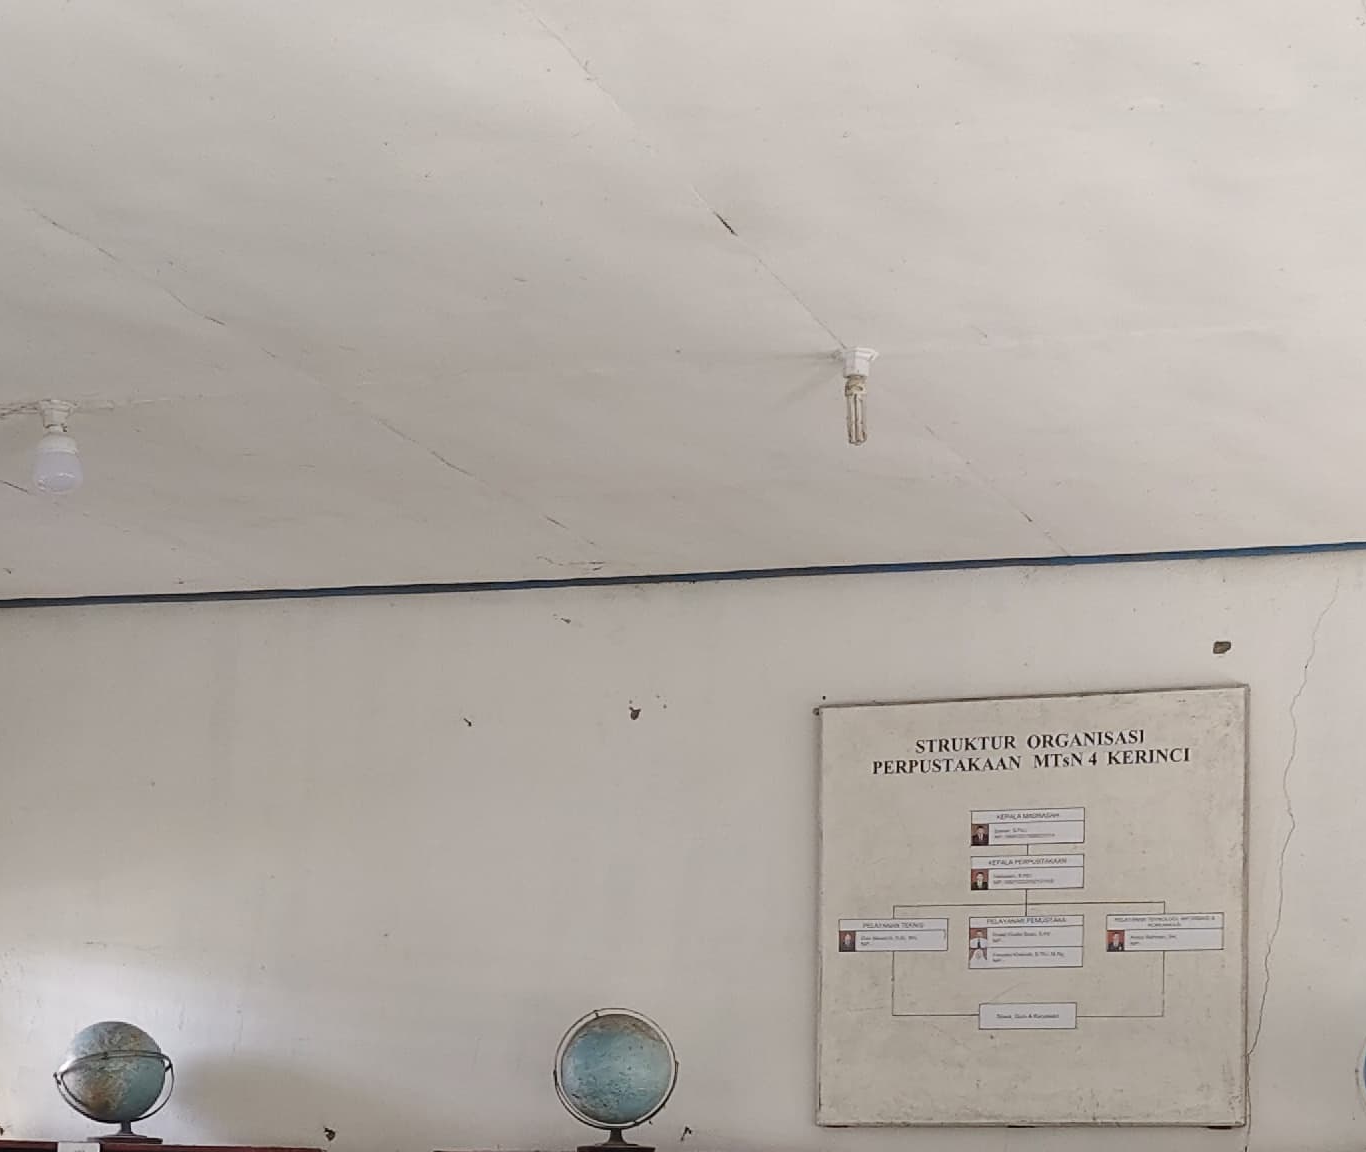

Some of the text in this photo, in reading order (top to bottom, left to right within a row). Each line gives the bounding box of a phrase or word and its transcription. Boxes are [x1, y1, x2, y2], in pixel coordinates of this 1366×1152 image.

[915, 729, 1144, 753] STRUKTUR ORGANISASI
[872, 747, 1190, 775] PERPUSTAKAAN MTsN 4 KERINCI
